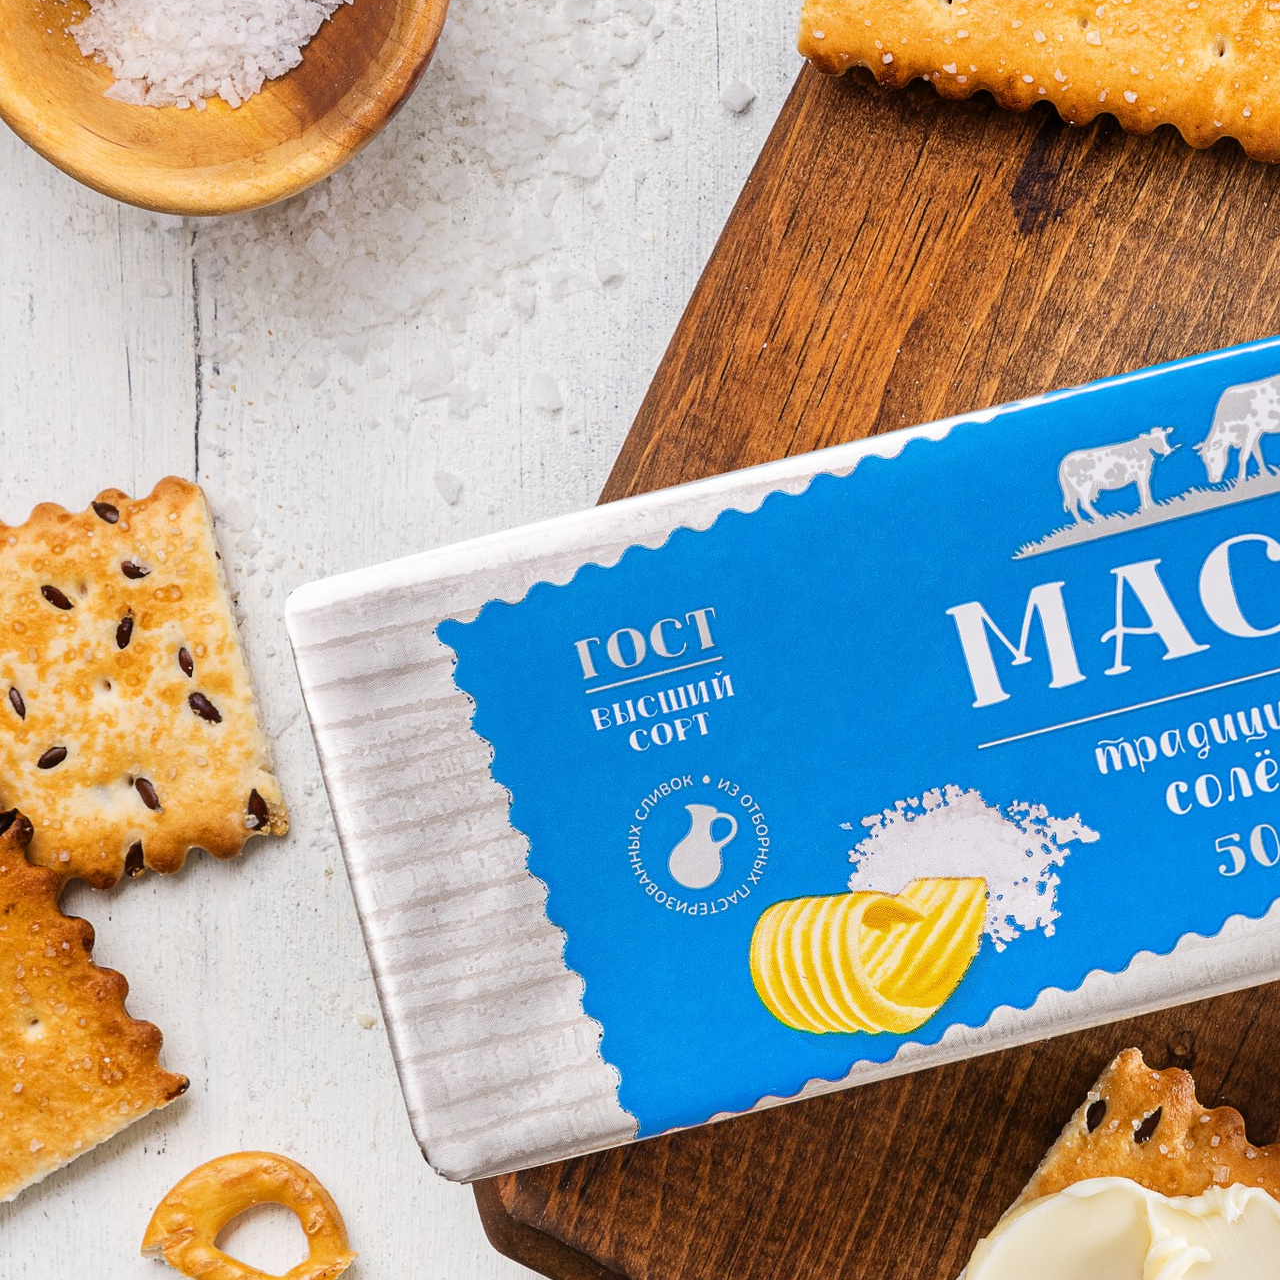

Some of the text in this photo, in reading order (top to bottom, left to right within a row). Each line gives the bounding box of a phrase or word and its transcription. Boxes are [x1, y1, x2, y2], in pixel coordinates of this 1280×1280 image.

[573, 607, 716, 680] ГОСТ
[590, 671, 735, 731] ВЫСШИЙ
[629, 712, 709, 751] СОРТ
[628, 775, 770, 915] ИЗ ОТБОРНЫХ ПАСТЕРИЗОВАННЫХ СЛИВОК
